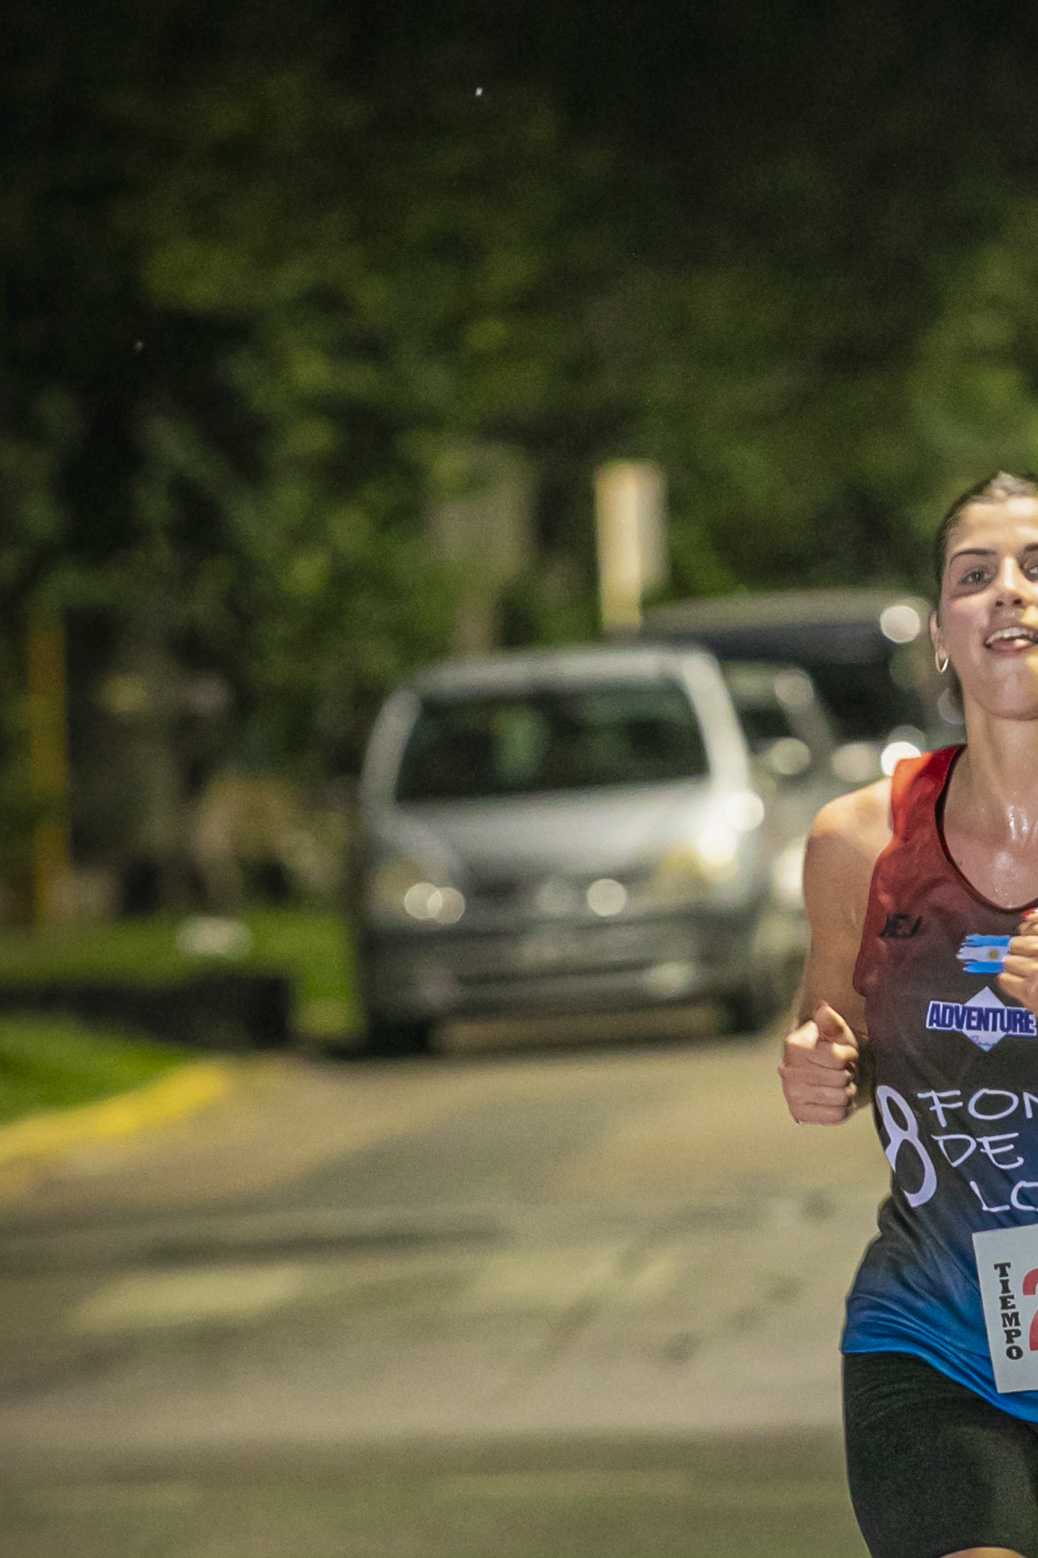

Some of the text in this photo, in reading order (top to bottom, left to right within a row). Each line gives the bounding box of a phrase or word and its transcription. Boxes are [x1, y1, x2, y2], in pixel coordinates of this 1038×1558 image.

[928, 1003, 1036, 1034] ADVENTURE
[876, 1085, 937, 1207] 8
[930, 1132, 1024, 1170] DE
[994, 1262, 1023, 1360] TIEMPO
